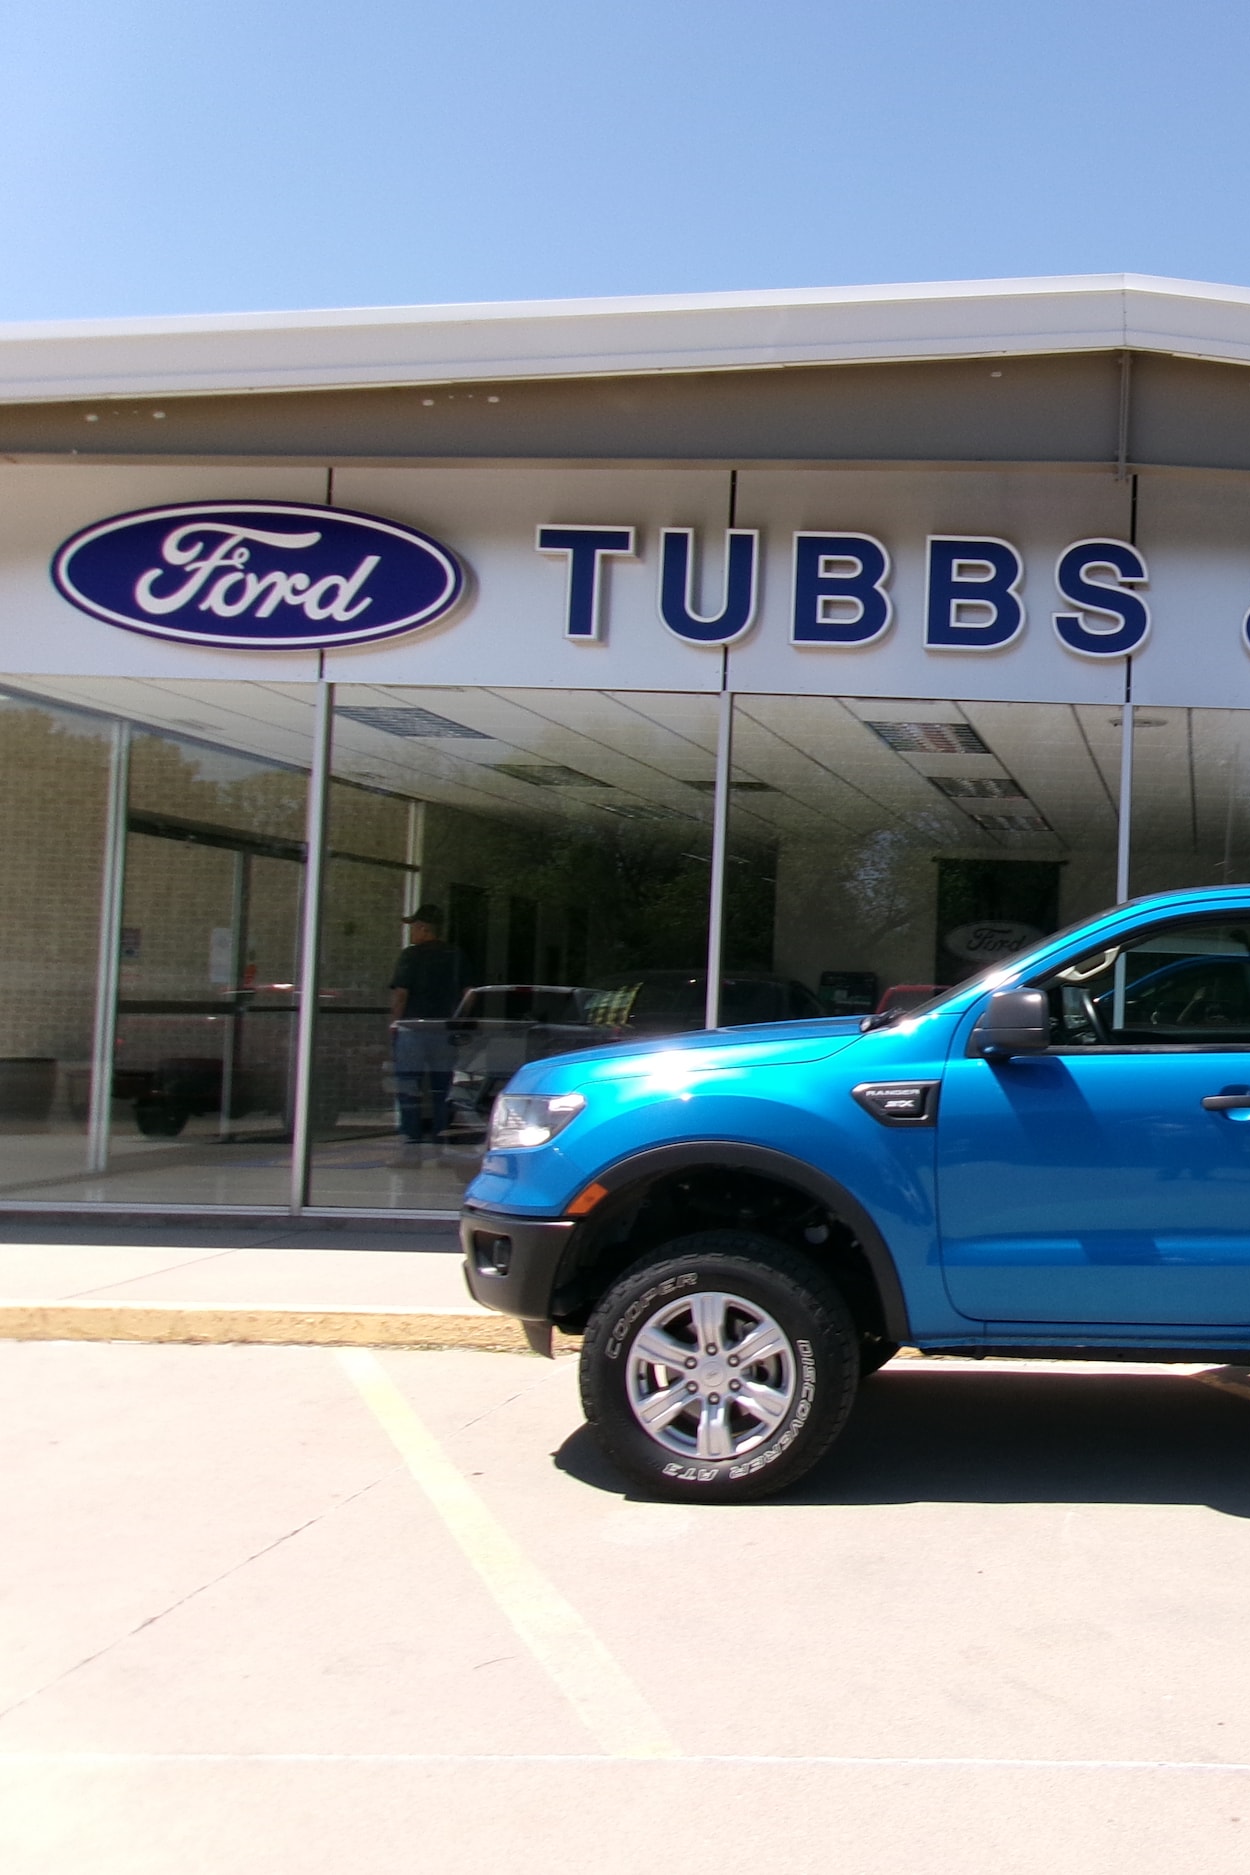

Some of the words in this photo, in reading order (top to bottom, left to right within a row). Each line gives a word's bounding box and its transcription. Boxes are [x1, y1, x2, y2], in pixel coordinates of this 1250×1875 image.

[134, 522, 382, 622] Ford
[535, 522, 1150, 659] TUBBS
[967, 927, 1027, 952] Ford
[865, 1088, 921, 1097] RANGER
[606, 1272, 699, 1359] COOPER
[728, 1338, 817, 1480] DISCOVERER
